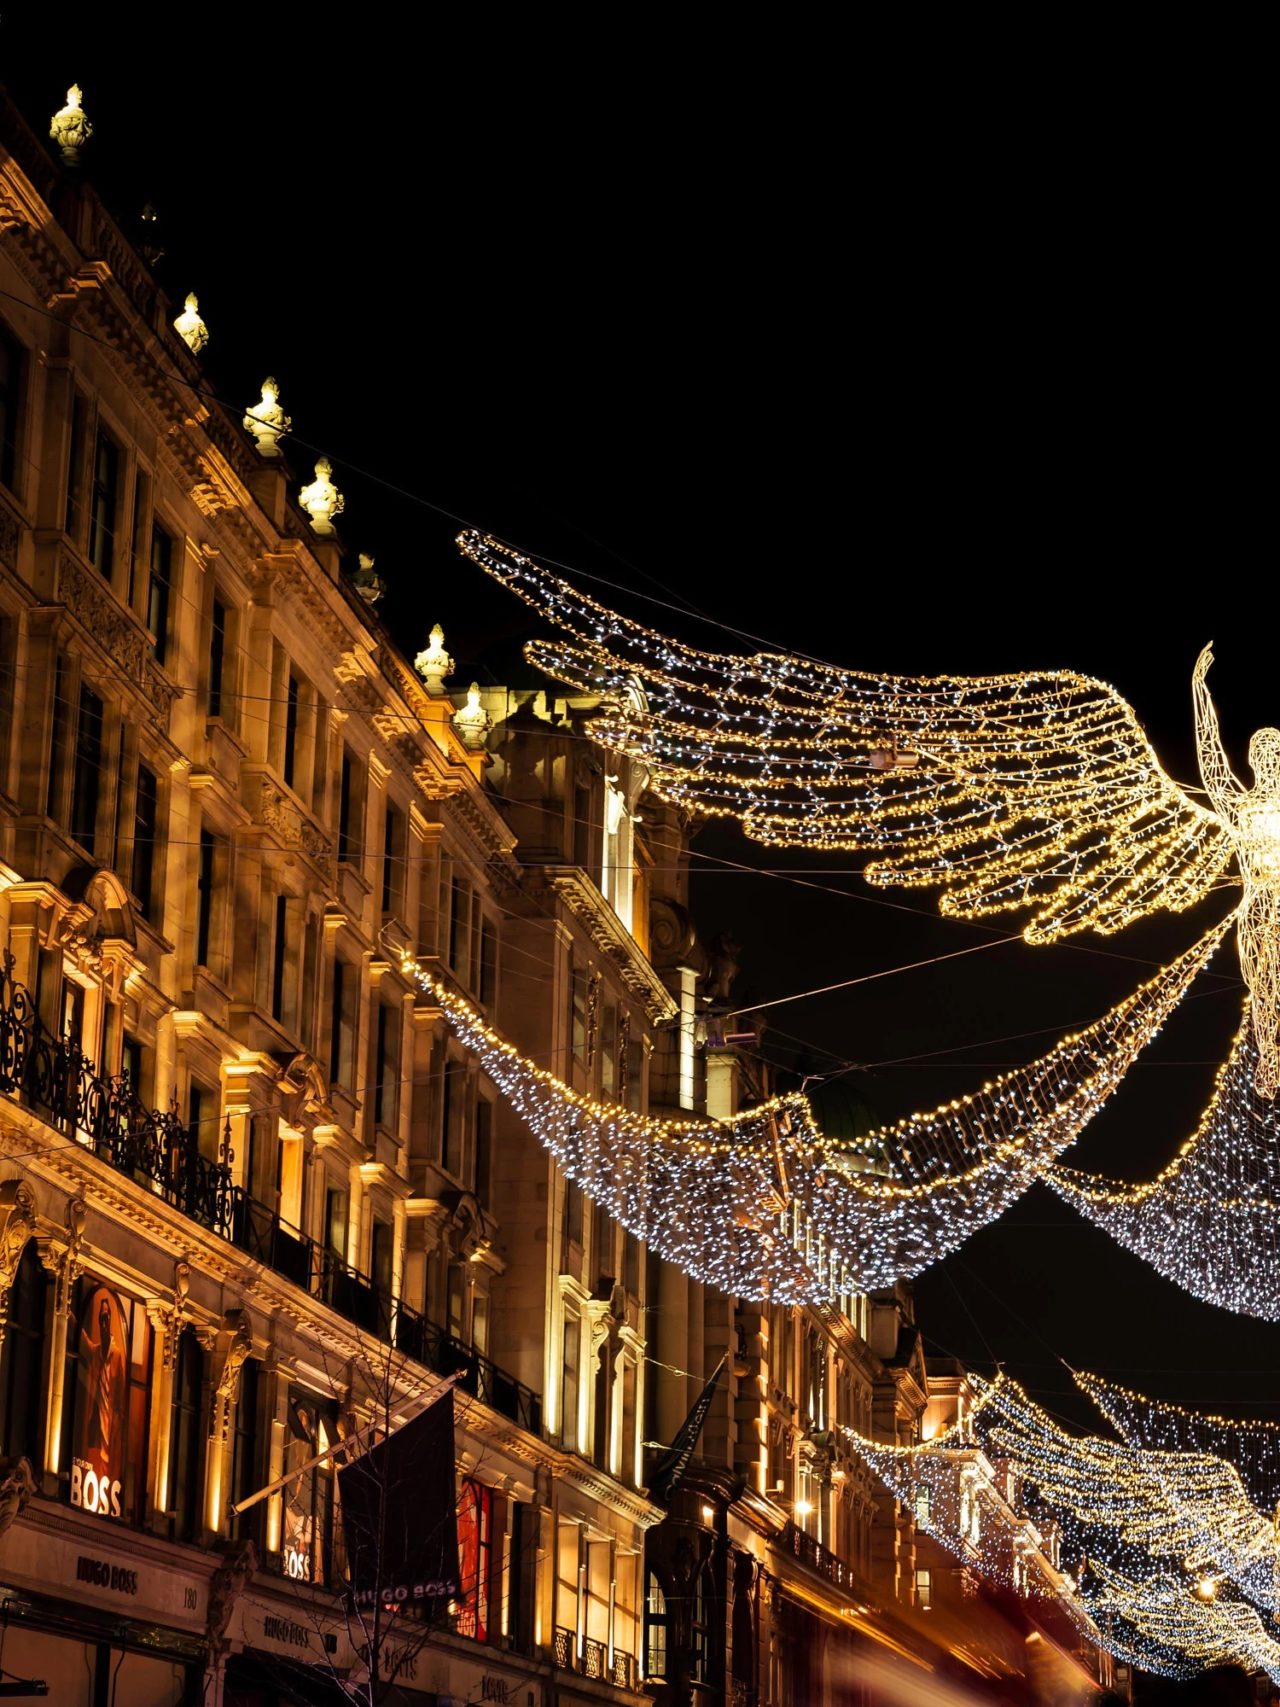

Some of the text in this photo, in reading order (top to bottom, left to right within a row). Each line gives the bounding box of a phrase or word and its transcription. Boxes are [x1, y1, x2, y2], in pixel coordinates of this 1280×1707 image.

[70, 1464, 122, 1518] BOSS
[77, 1556, 138, 1596] HUGO BOSS
[413, 1580, 457, 1600] BOSS
[184, 1586, 197, 1610] 180
